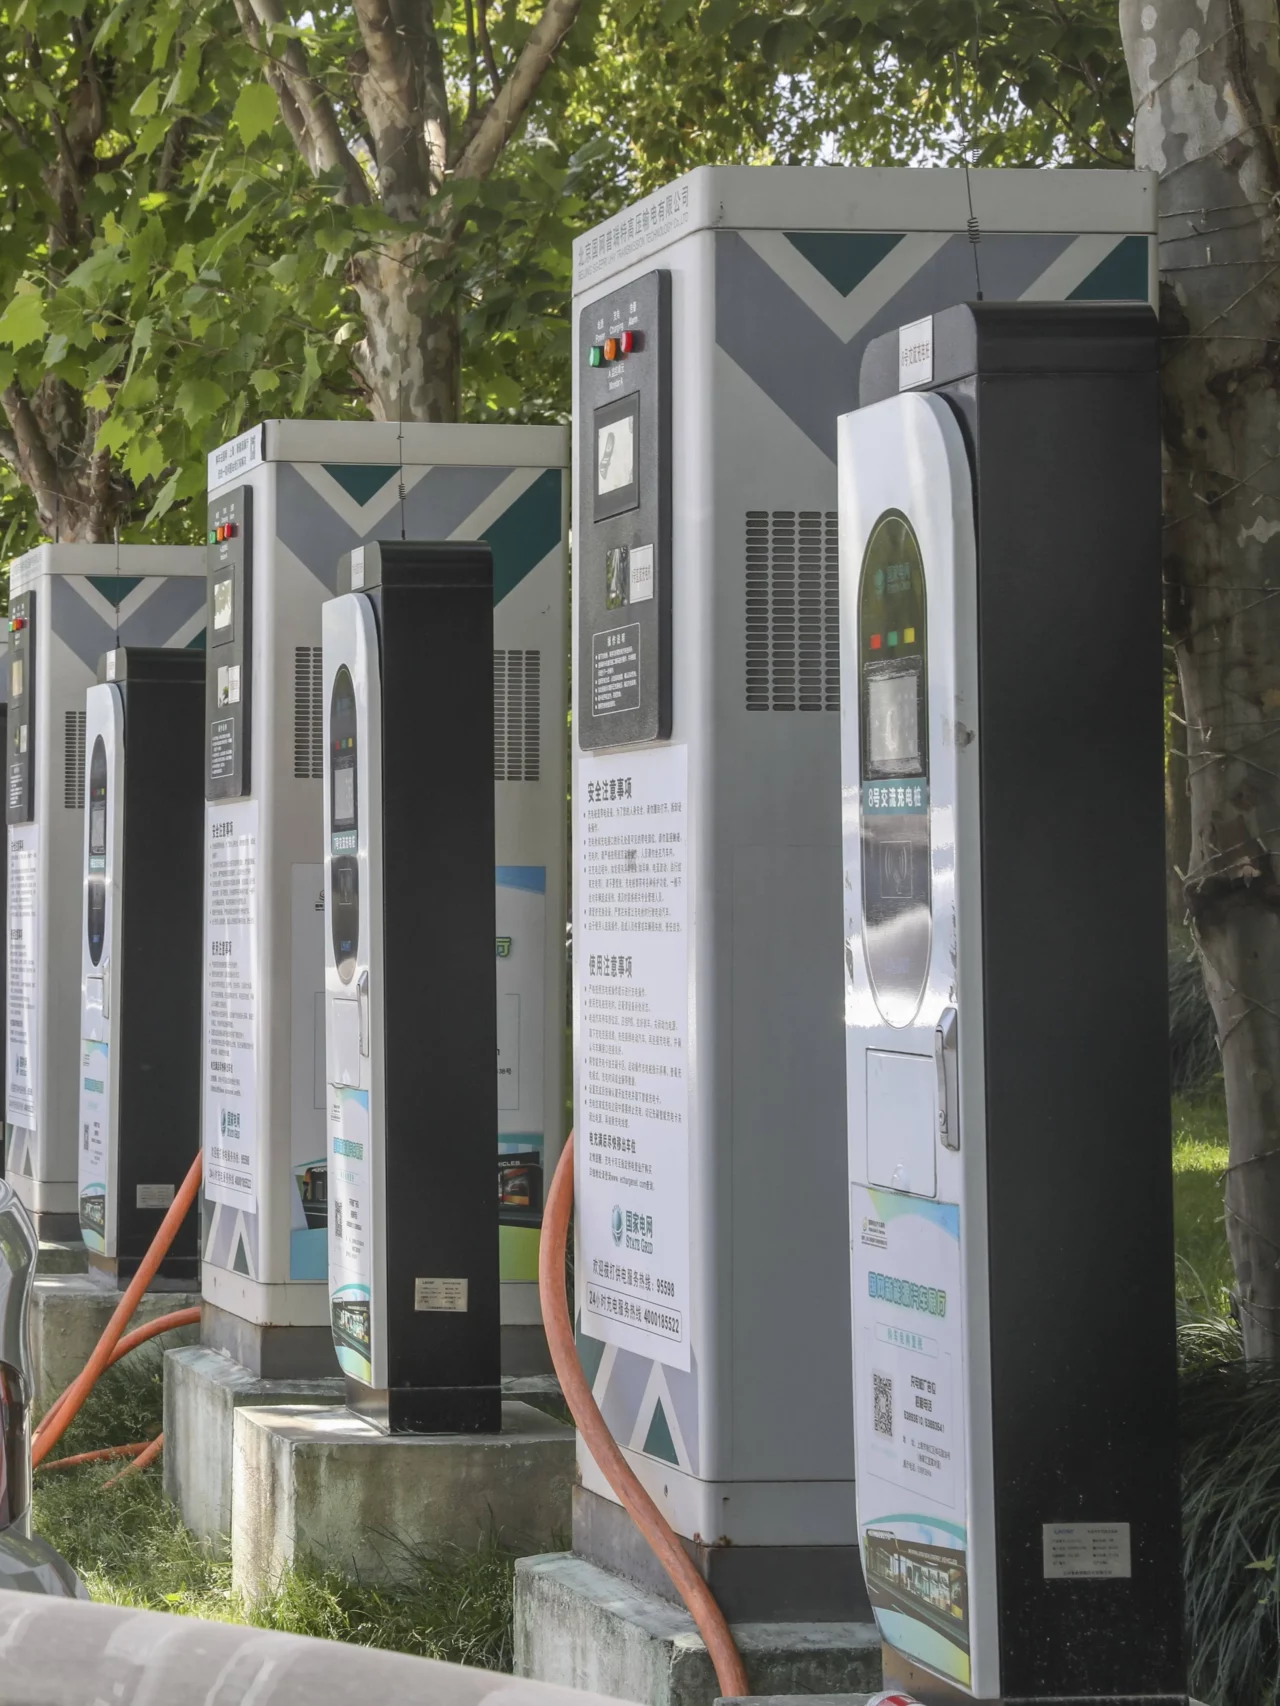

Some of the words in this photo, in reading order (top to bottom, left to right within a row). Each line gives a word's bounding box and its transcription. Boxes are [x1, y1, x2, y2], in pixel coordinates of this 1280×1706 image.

[588, 777, 632, 803] 安全注意事项
[868, 785, 922, 809] 8号交流充电桩
[589, 954, 633, 978] 使用注意事项
[625, 1210, 653, 1239] 国家电网
